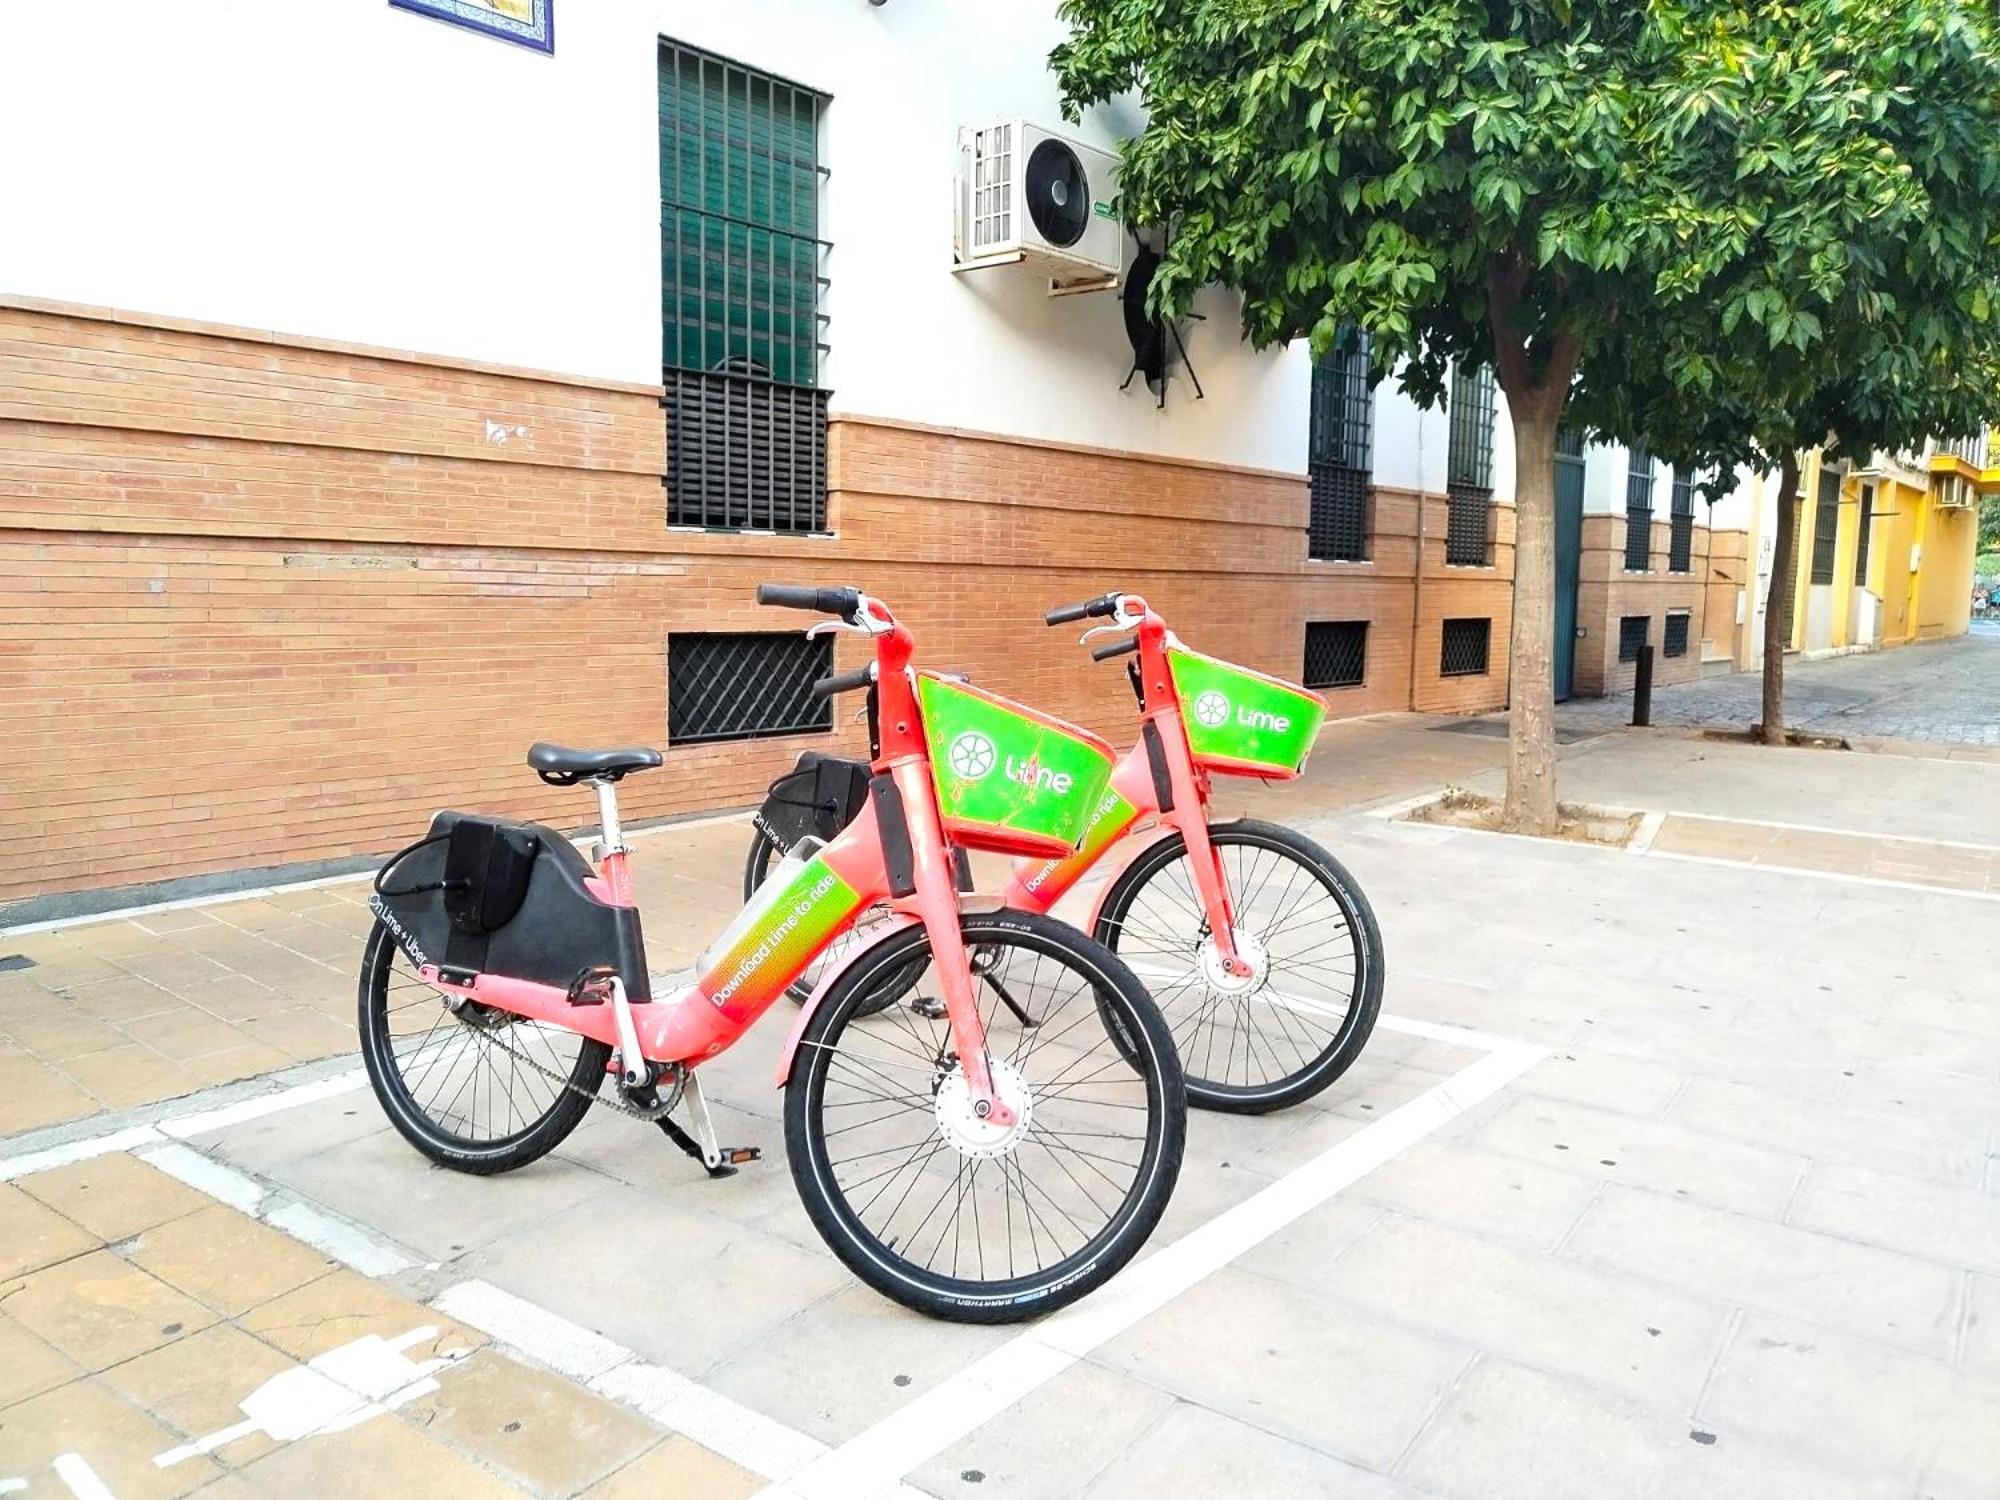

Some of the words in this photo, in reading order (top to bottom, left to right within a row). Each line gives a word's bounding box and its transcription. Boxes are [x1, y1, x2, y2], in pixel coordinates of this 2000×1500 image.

[1237, 705, 1291, 733] Lime
[763, 821, 780, 844] Lime
[369, 893, 384, 914] On
[381, 905, 402, 936] Lime
[405, 934, 428, 965] Uber
[711, 942, 772, 1007] Download
[767, 914, 798, 947] Lime
[795, 901, 812, 916] to
[811, 875, 835, 901] ride
